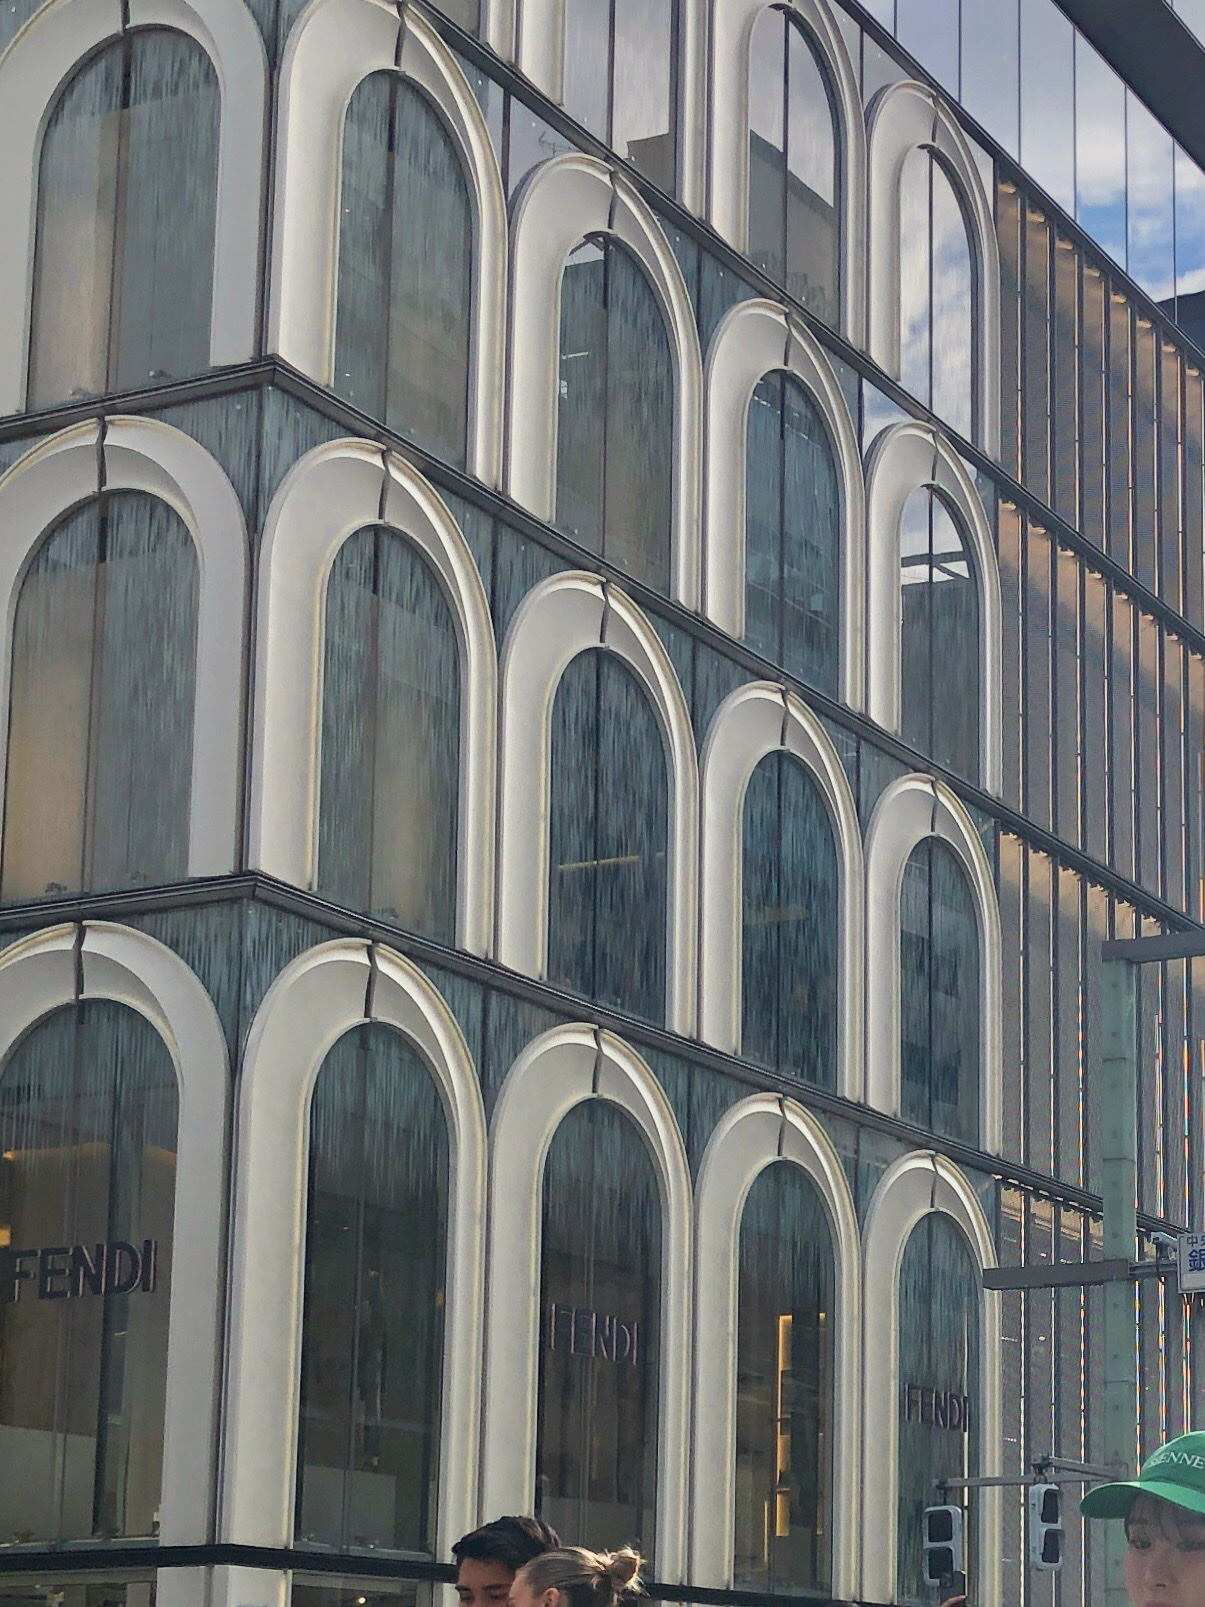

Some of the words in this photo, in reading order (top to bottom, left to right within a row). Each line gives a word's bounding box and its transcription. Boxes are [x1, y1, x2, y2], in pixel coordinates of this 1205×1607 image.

[9, 1240, 157, 1303] FENDI
[550, 1303, 638, 1366] FENDI
[904, 1382, 969, 1433] FENDI
